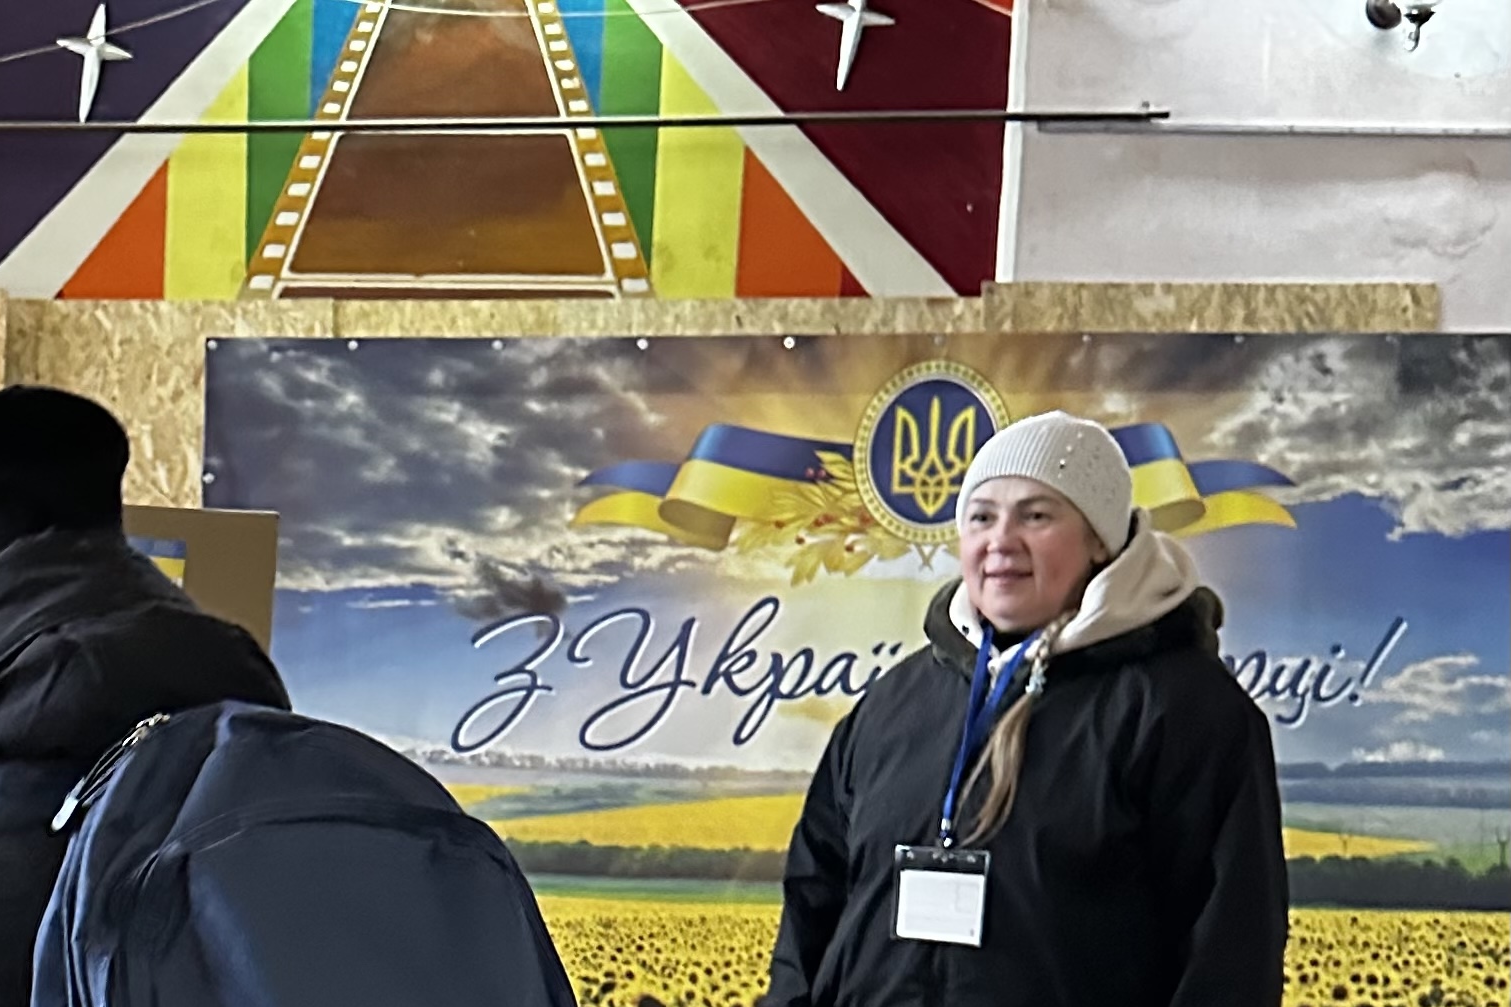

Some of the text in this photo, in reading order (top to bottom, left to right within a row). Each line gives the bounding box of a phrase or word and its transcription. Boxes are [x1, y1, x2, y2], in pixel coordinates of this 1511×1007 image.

[451, 597, 1408, 753] З Украї рці!
